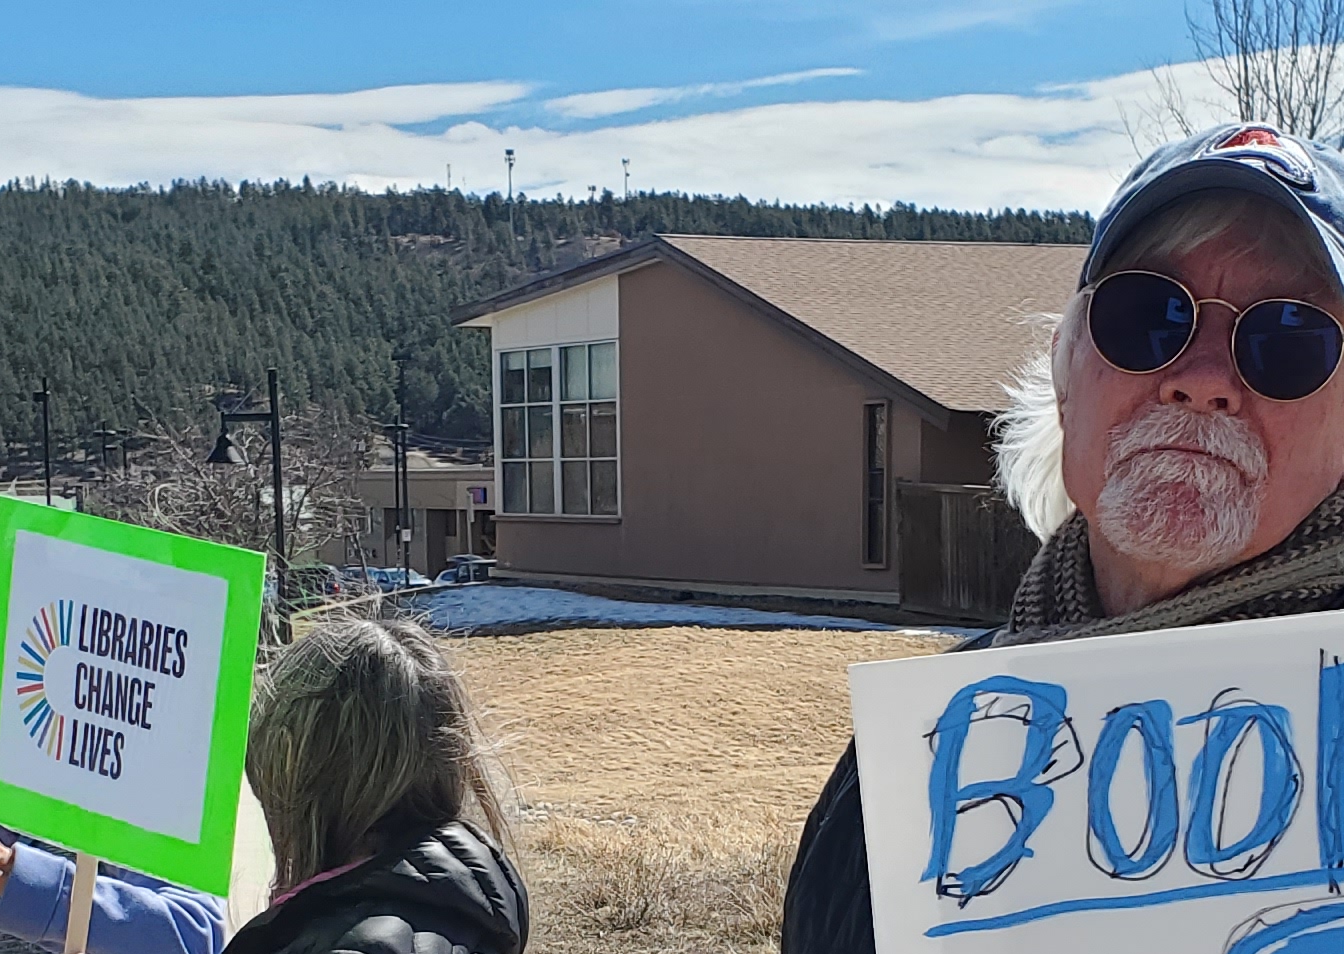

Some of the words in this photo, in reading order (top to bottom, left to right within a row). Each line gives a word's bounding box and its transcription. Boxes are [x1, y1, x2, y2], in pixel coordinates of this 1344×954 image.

[78, 603, 189, 679] LIBRARIES
[74, 662, 156, 730] CHANGE
[68, 718, 125, 781] LIVES
